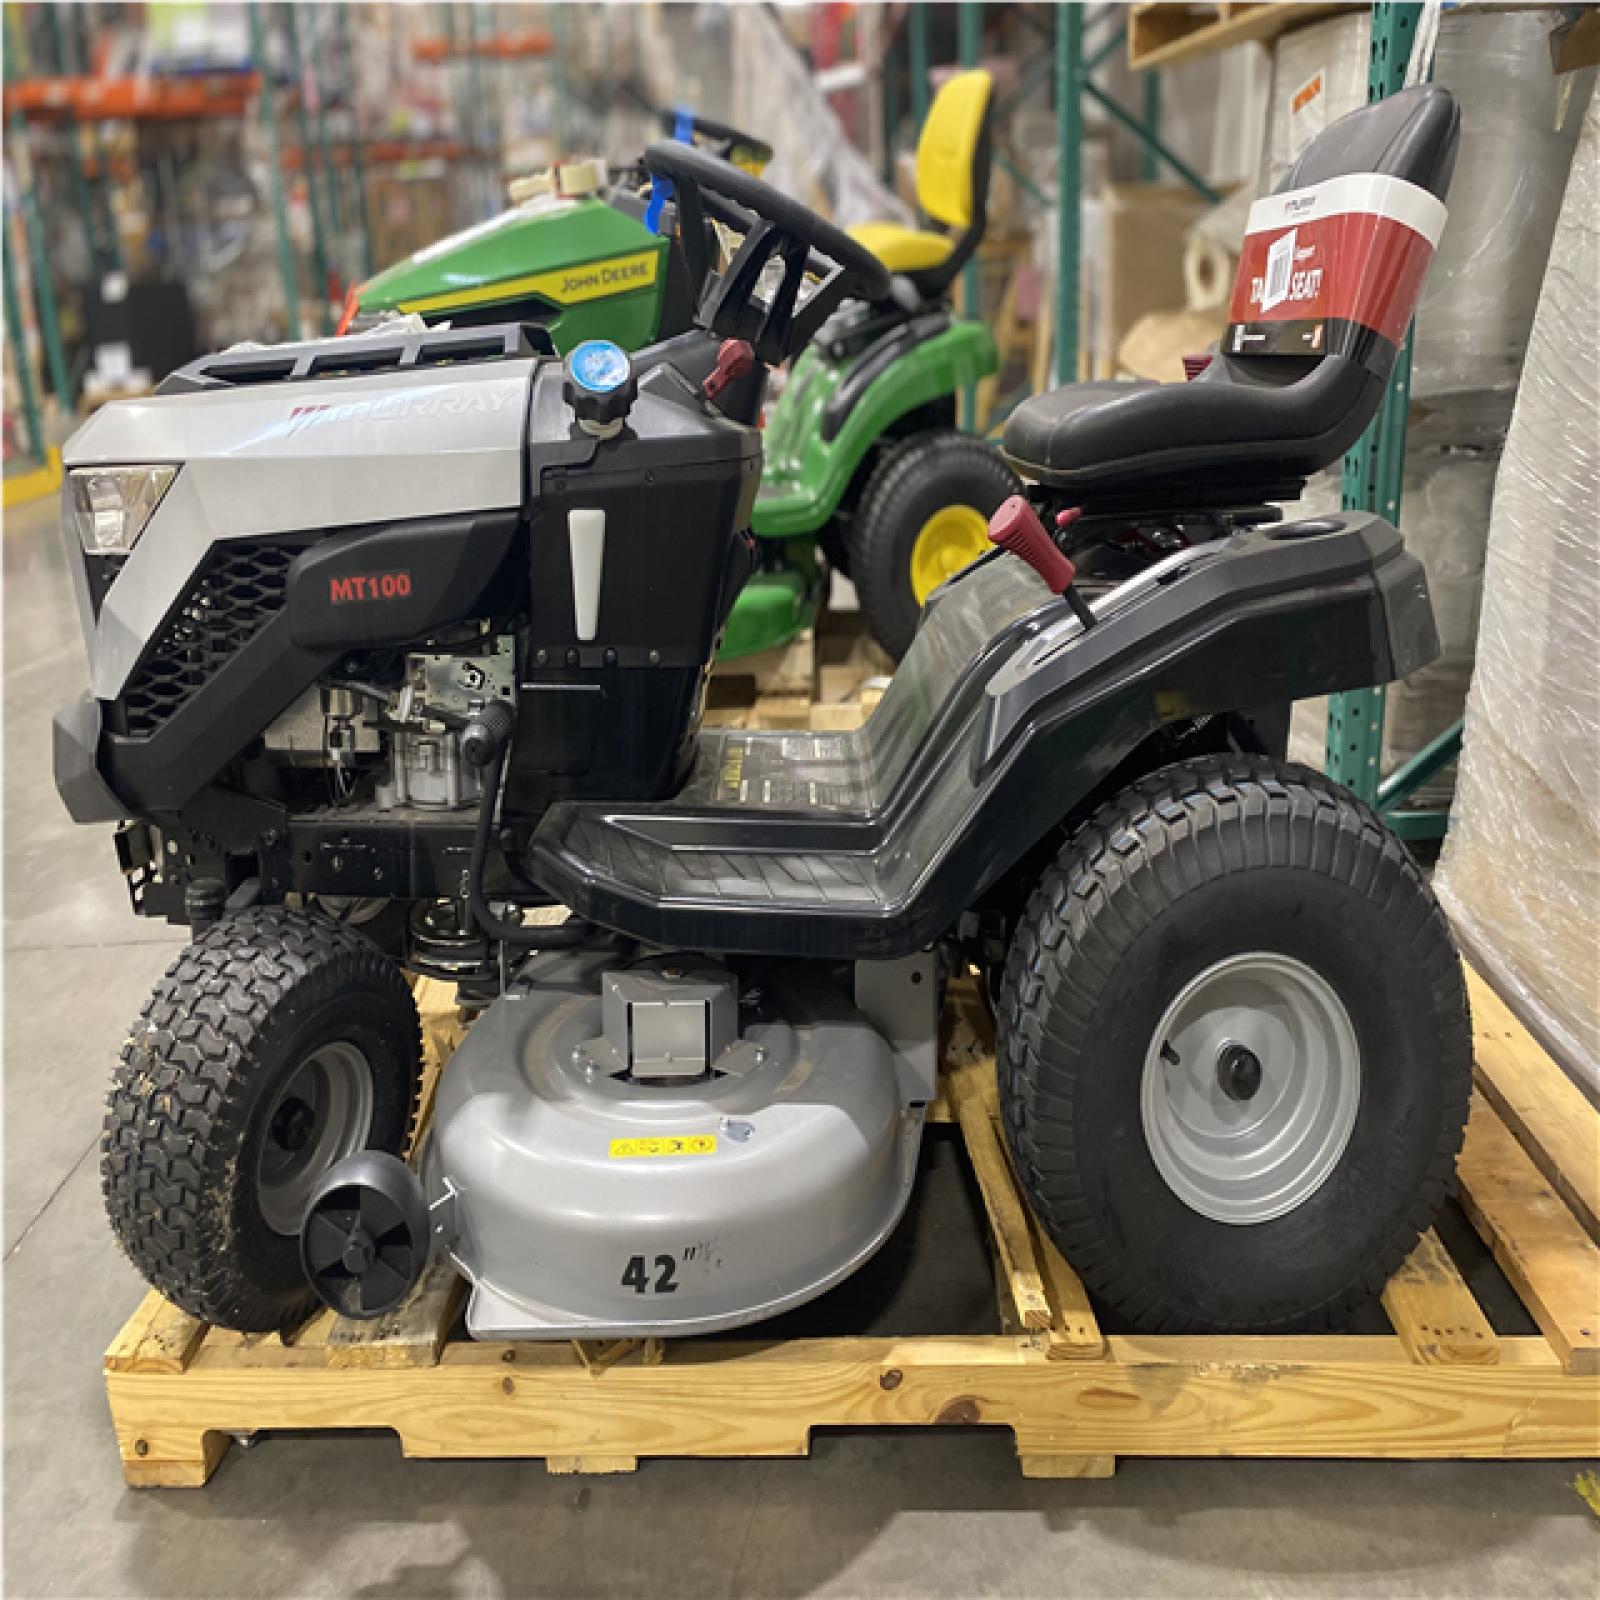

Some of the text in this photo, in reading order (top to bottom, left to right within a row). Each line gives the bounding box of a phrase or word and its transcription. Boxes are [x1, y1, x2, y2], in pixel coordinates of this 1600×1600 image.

[561, 262, 648, 293] JOHN DEERE
[329, 574, 411, 604] MT100
